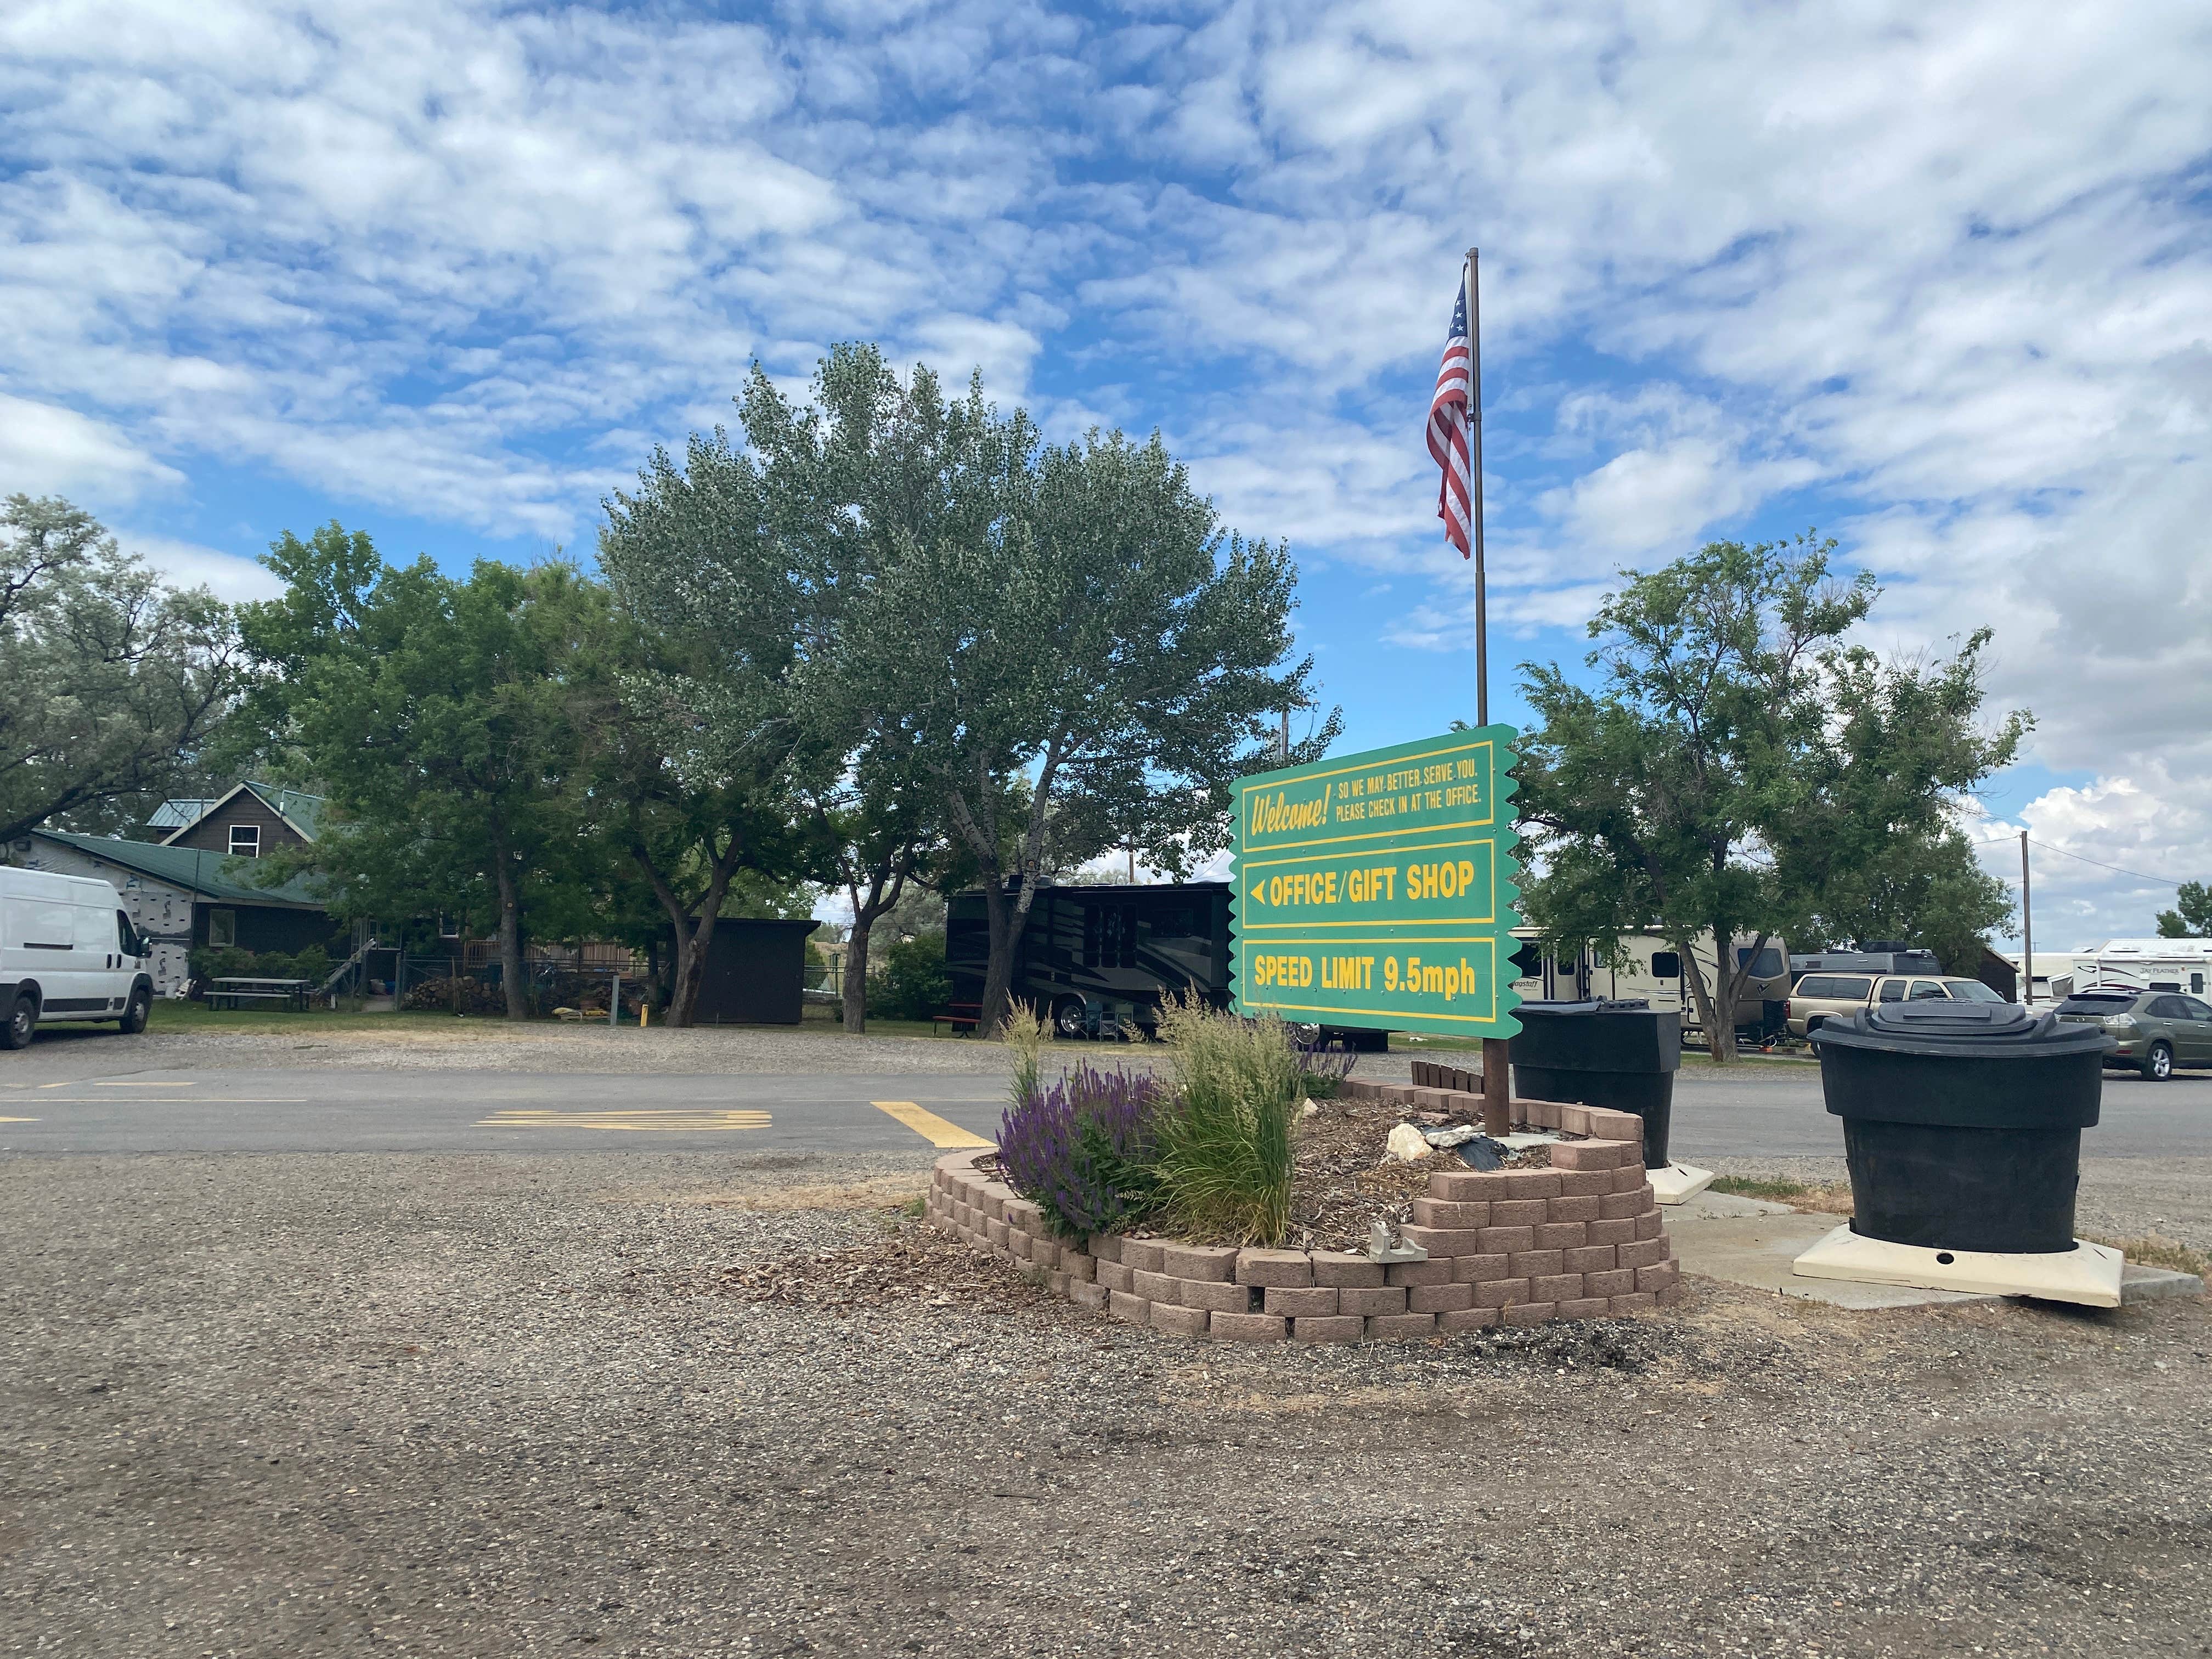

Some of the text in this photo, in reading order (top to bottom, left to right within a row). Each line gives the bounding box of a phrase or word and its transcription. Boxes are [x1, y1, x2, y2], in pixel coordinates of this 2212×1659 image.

[1339, 760, 1477, 799] SO WE MAY BETTER SERVE YOU.
[1250, 783, 1331, 836] Welcome!
[1336, 784, 1481, 821] PLEASE CHECK IN AT THE OFFICE.
[1270, 861, 1474, 906] OFFICE/GIFT SHOP
[1255, 955, 1475, 1001] SPEED LIMIT 9.5mph
